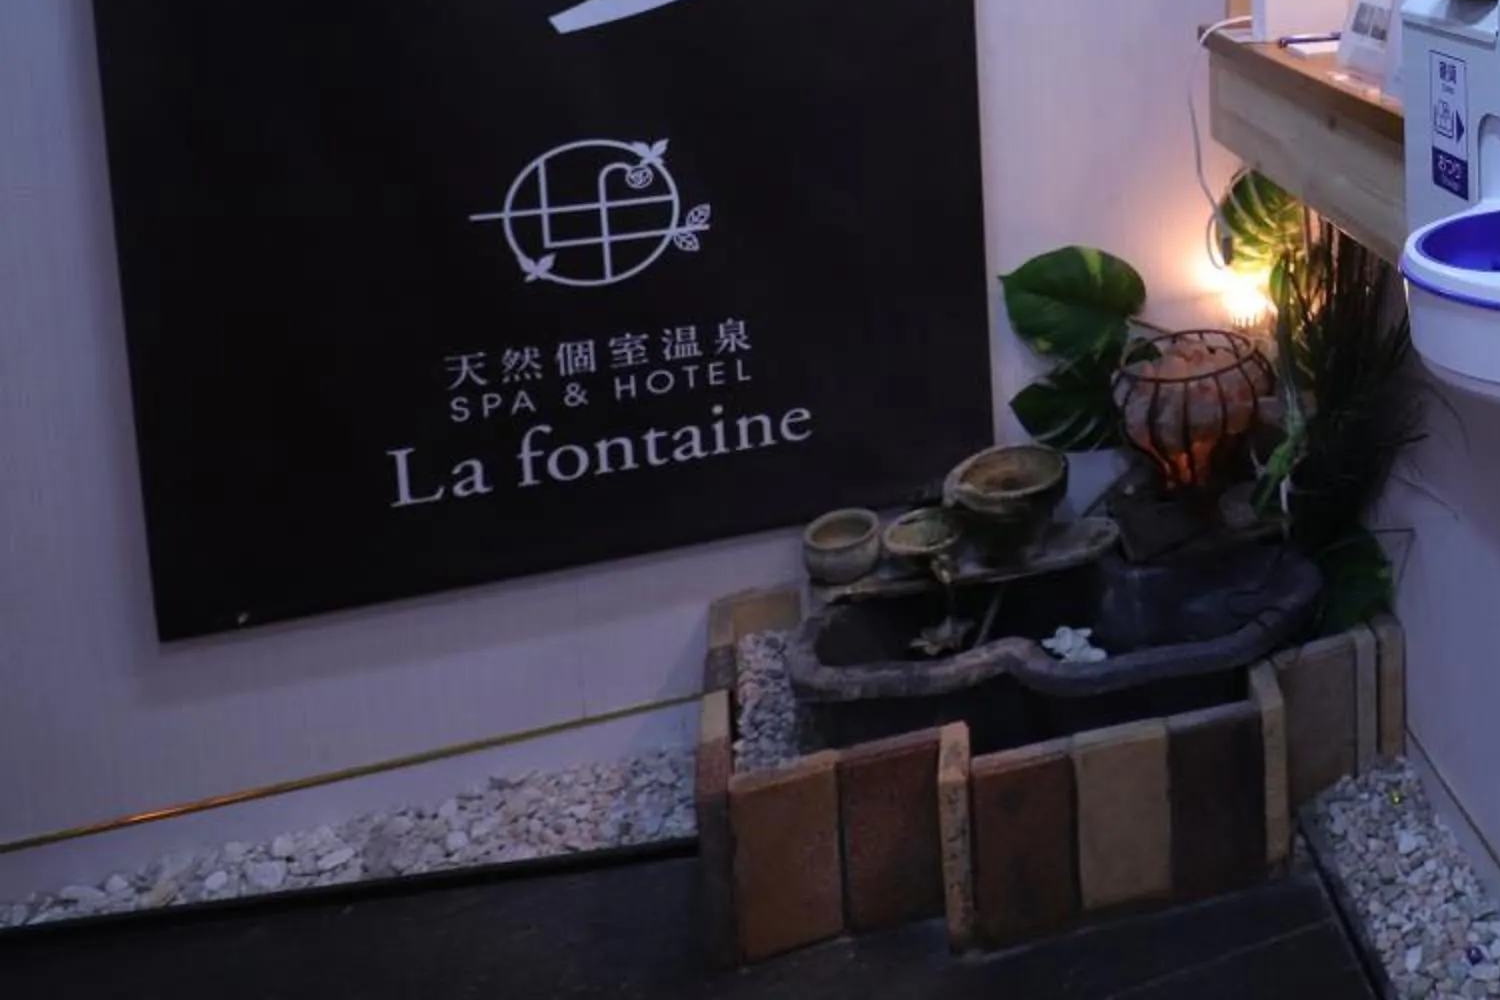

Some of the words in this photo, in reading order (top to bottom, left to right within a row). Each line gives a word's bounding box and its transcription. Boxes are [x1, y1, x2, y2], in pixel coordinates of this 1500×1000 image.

[443, 317, 752, 390] 天然個室温泉
[450, 390, 537, 422] SPA
[563, 382, 588, 407] &
[614, 358, 752, 401] HOTEL
[386, 446, 493, 507] La
[517, 404, 813, 487] fontaine
